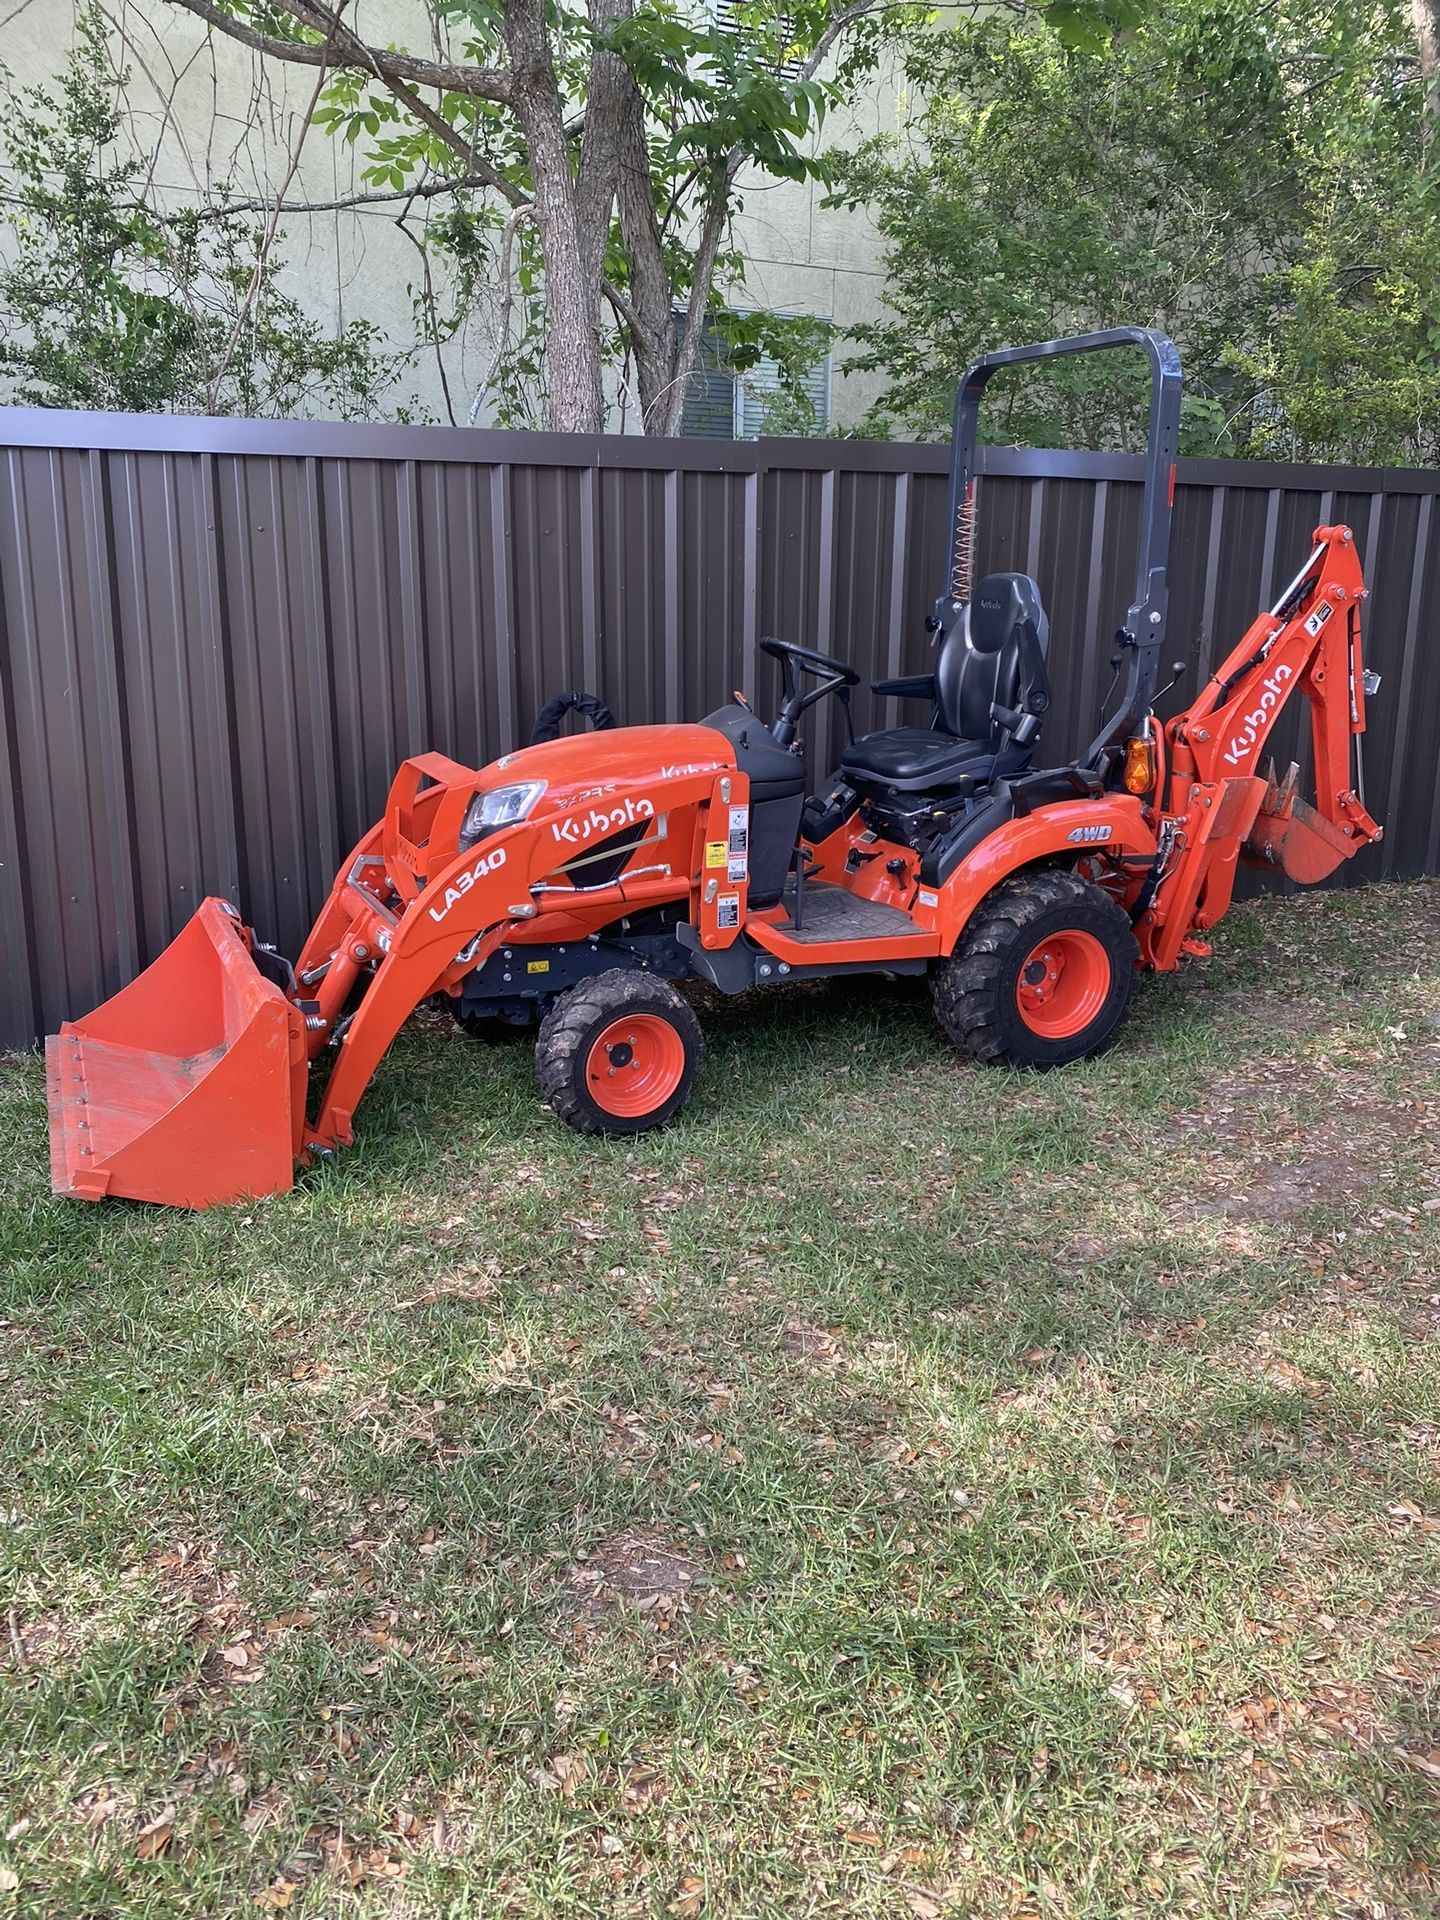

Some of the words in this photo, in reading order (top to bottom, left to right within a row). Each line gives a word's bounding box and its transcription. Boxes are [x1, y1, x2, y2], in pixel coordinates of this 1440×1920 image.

[1224, 665, 1292, 765] Kubota
[552, 799, 655, 842] Kubota
[1066, 825, 1112, 843] 4WD
[428, 847, 508, 922] LA340
